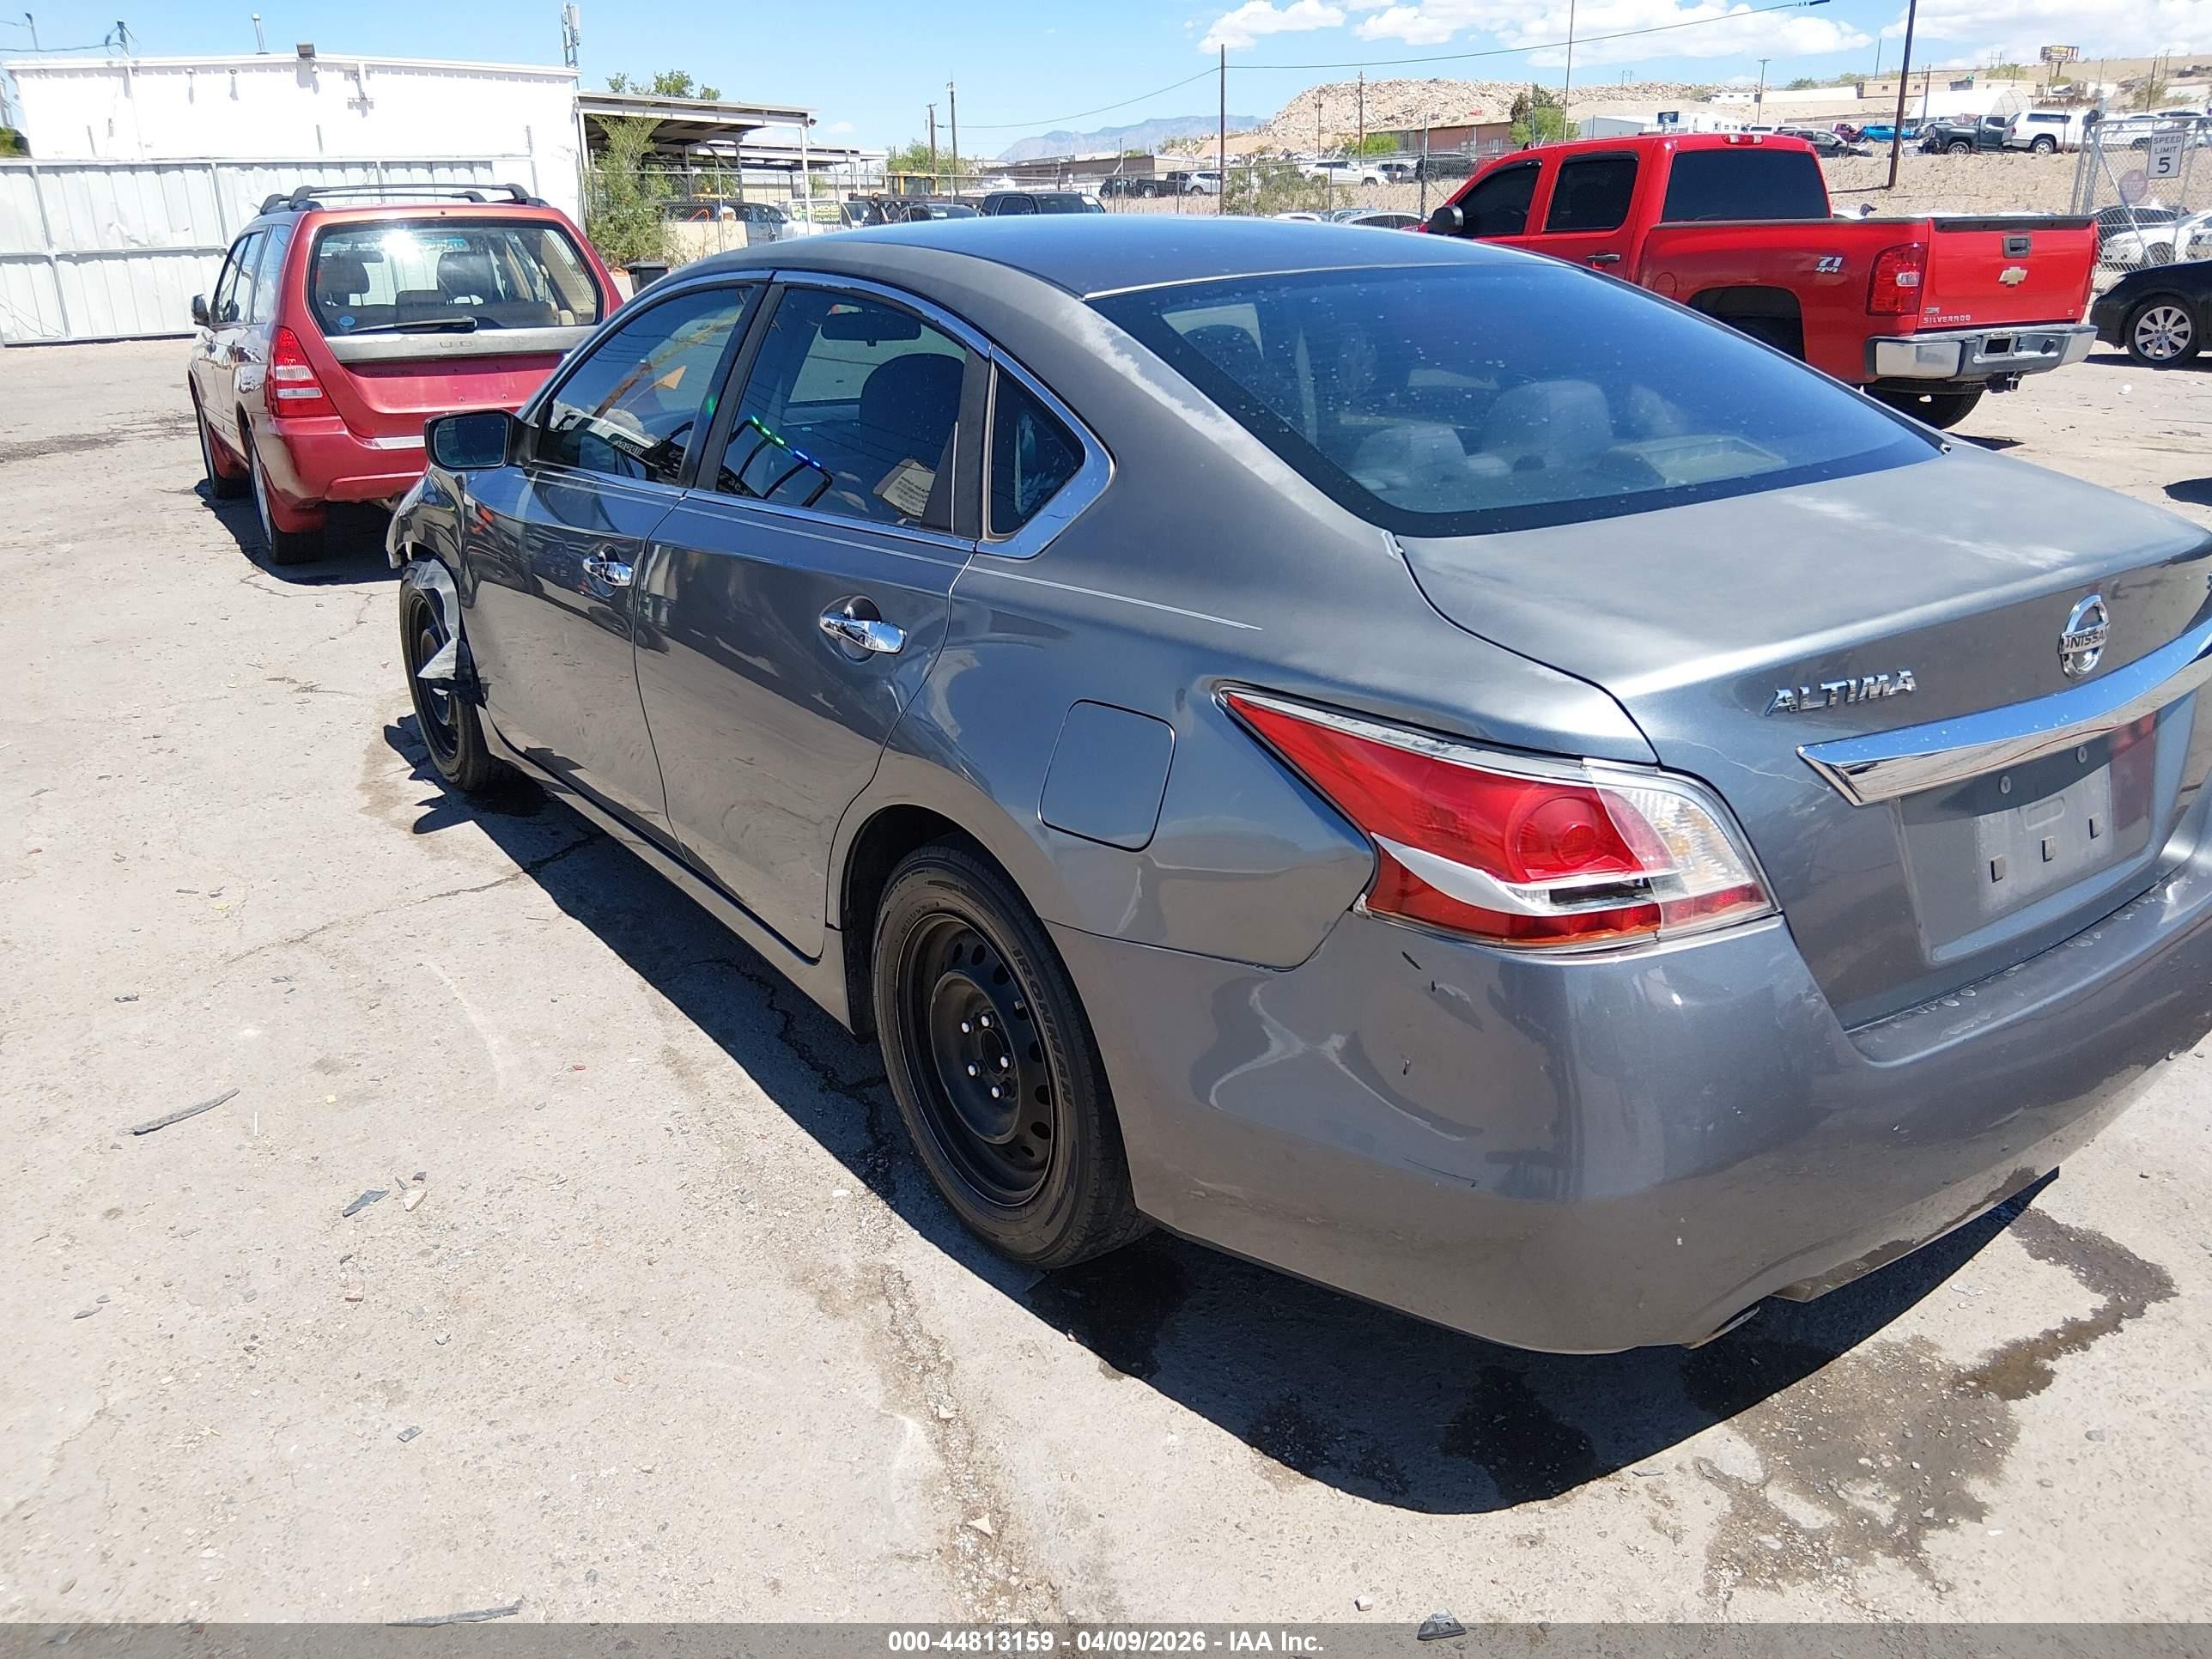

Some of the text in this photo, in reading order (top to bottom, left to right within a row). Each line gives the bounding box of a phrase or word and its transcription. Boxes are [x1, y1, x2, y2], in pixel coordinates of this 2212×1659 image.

[2153, 136, 2181, 144] SPEED
[2156, 156, 2172, 174] 5
[2121, 181, 2145, 191] STOP
[1923, 314, 1972, 324] SILVERADO
[2069, 628, 2106, 649] NISSA
[1765, 670, 1917, 716] ALTIMA
